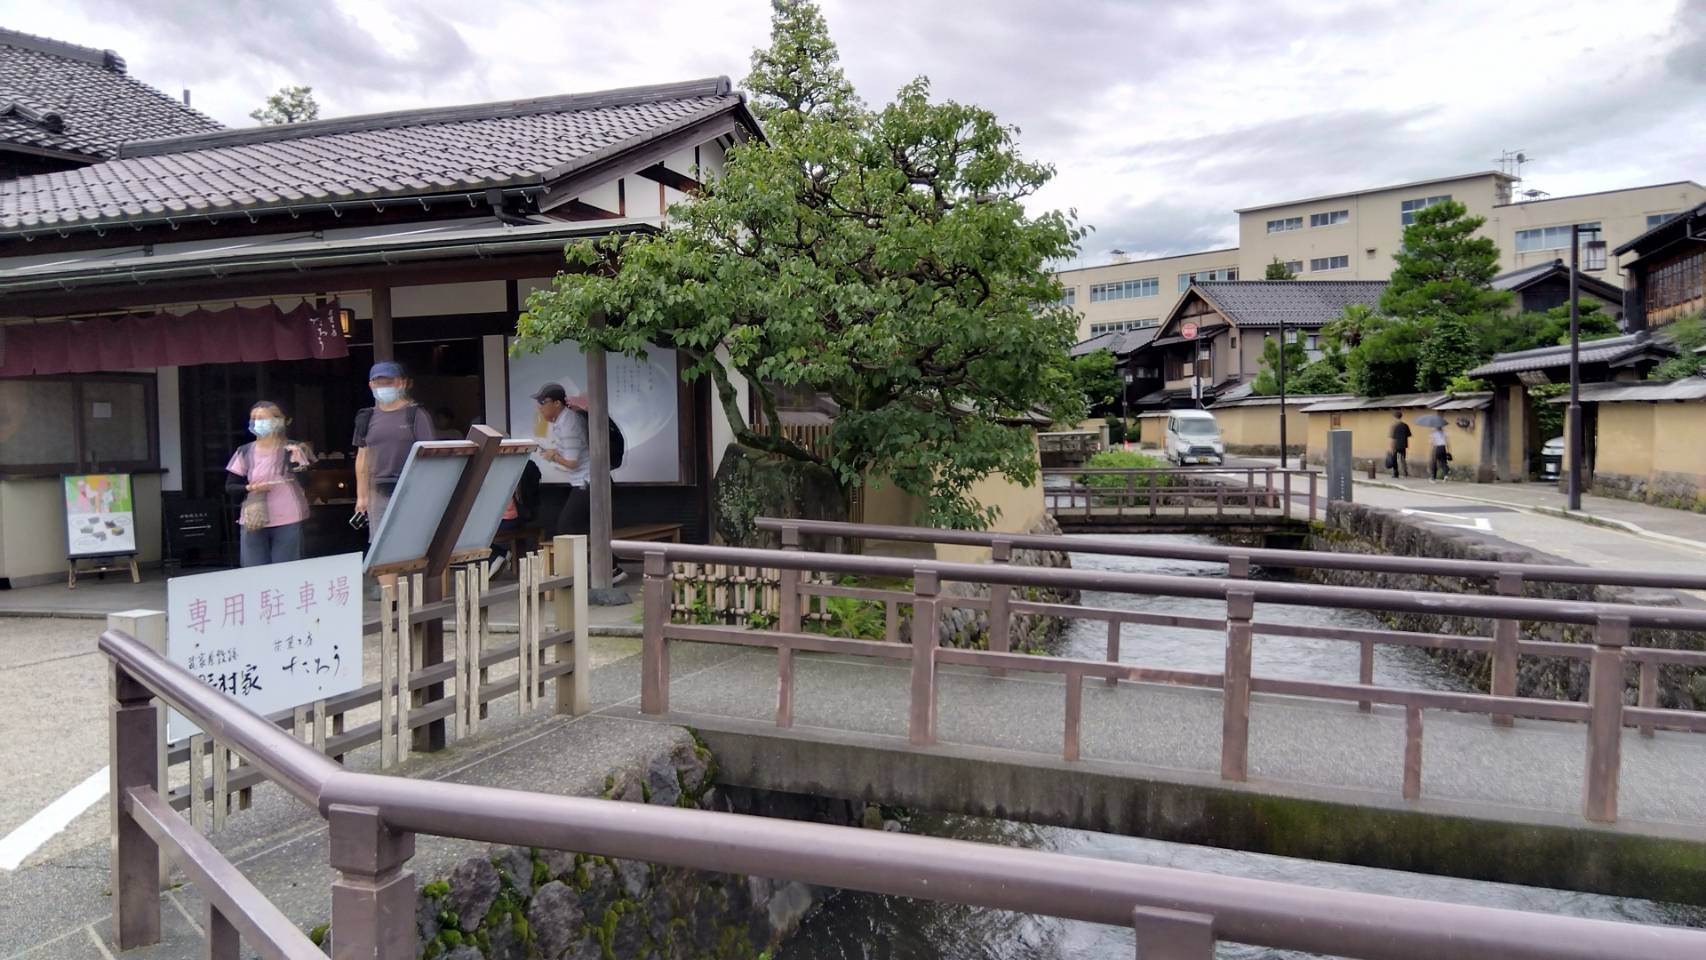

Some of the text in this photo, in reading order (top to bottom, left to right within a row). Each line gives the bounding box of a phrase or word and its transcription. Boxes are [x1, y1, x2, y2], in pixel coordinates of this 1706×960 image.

[187, 575, 350, 634] 専用駐車場
[282, 645, 340, 677] たろう
